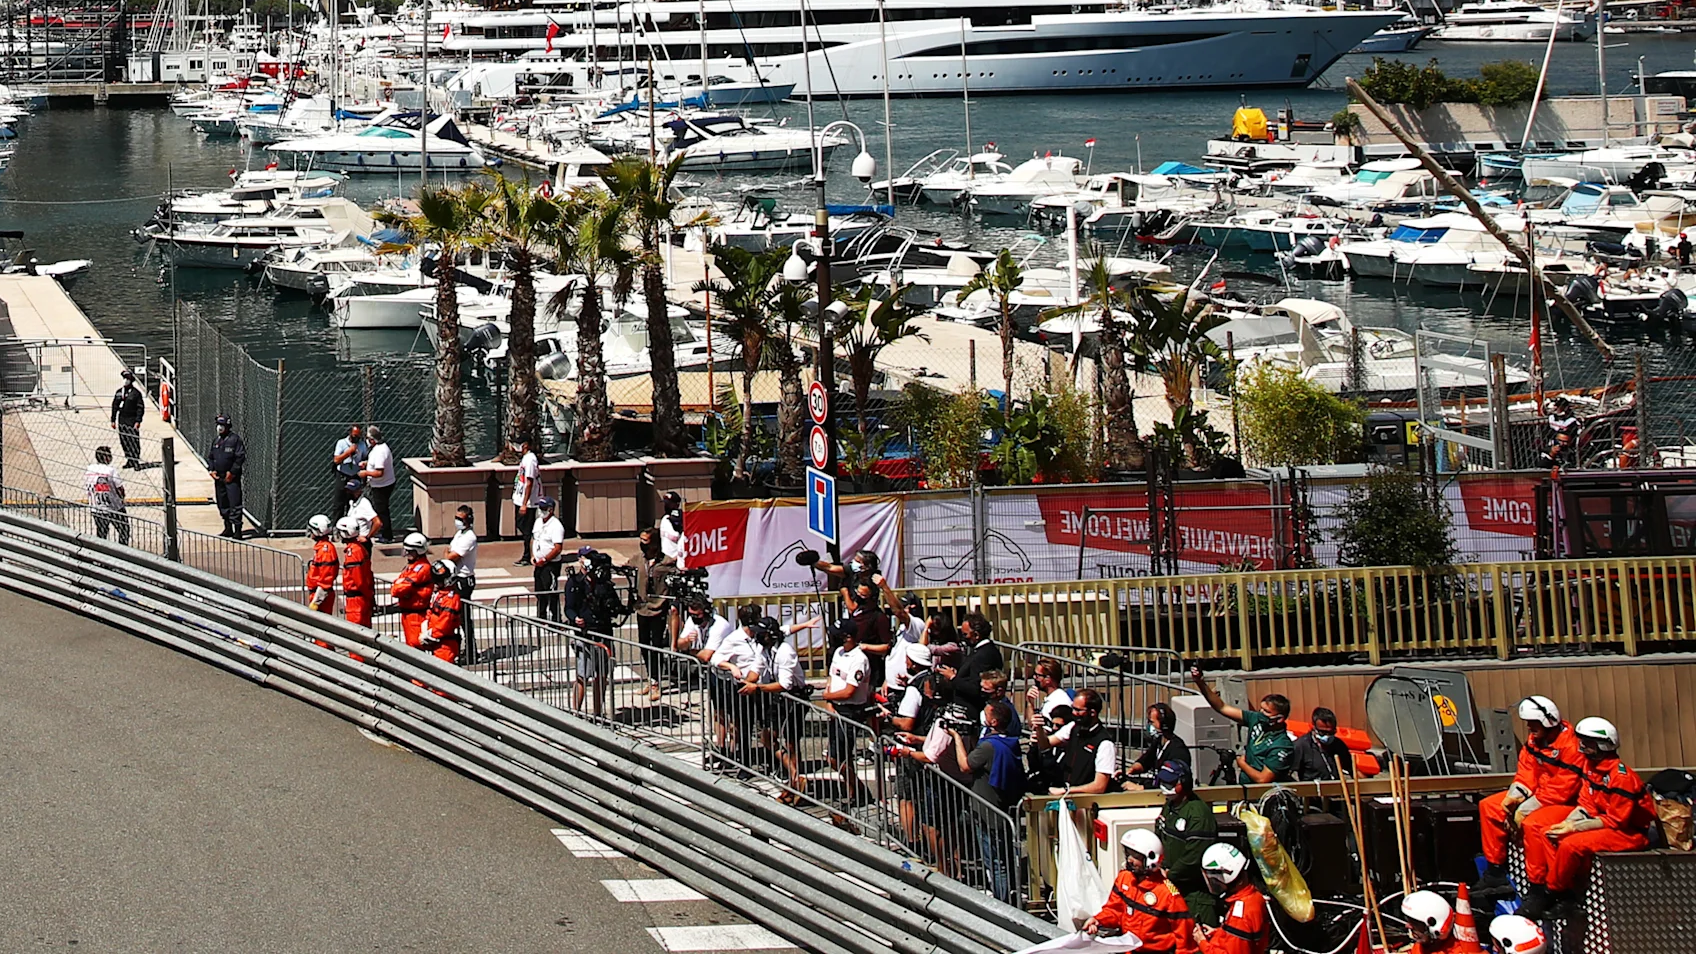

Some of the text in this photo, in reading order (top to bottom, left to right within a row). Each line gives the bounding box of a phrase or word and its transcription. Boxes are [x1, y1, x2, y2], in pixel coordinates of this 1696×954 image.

[812, 393, 823, 412] 30
[772, 580, 822, 589] SINCE 1929
